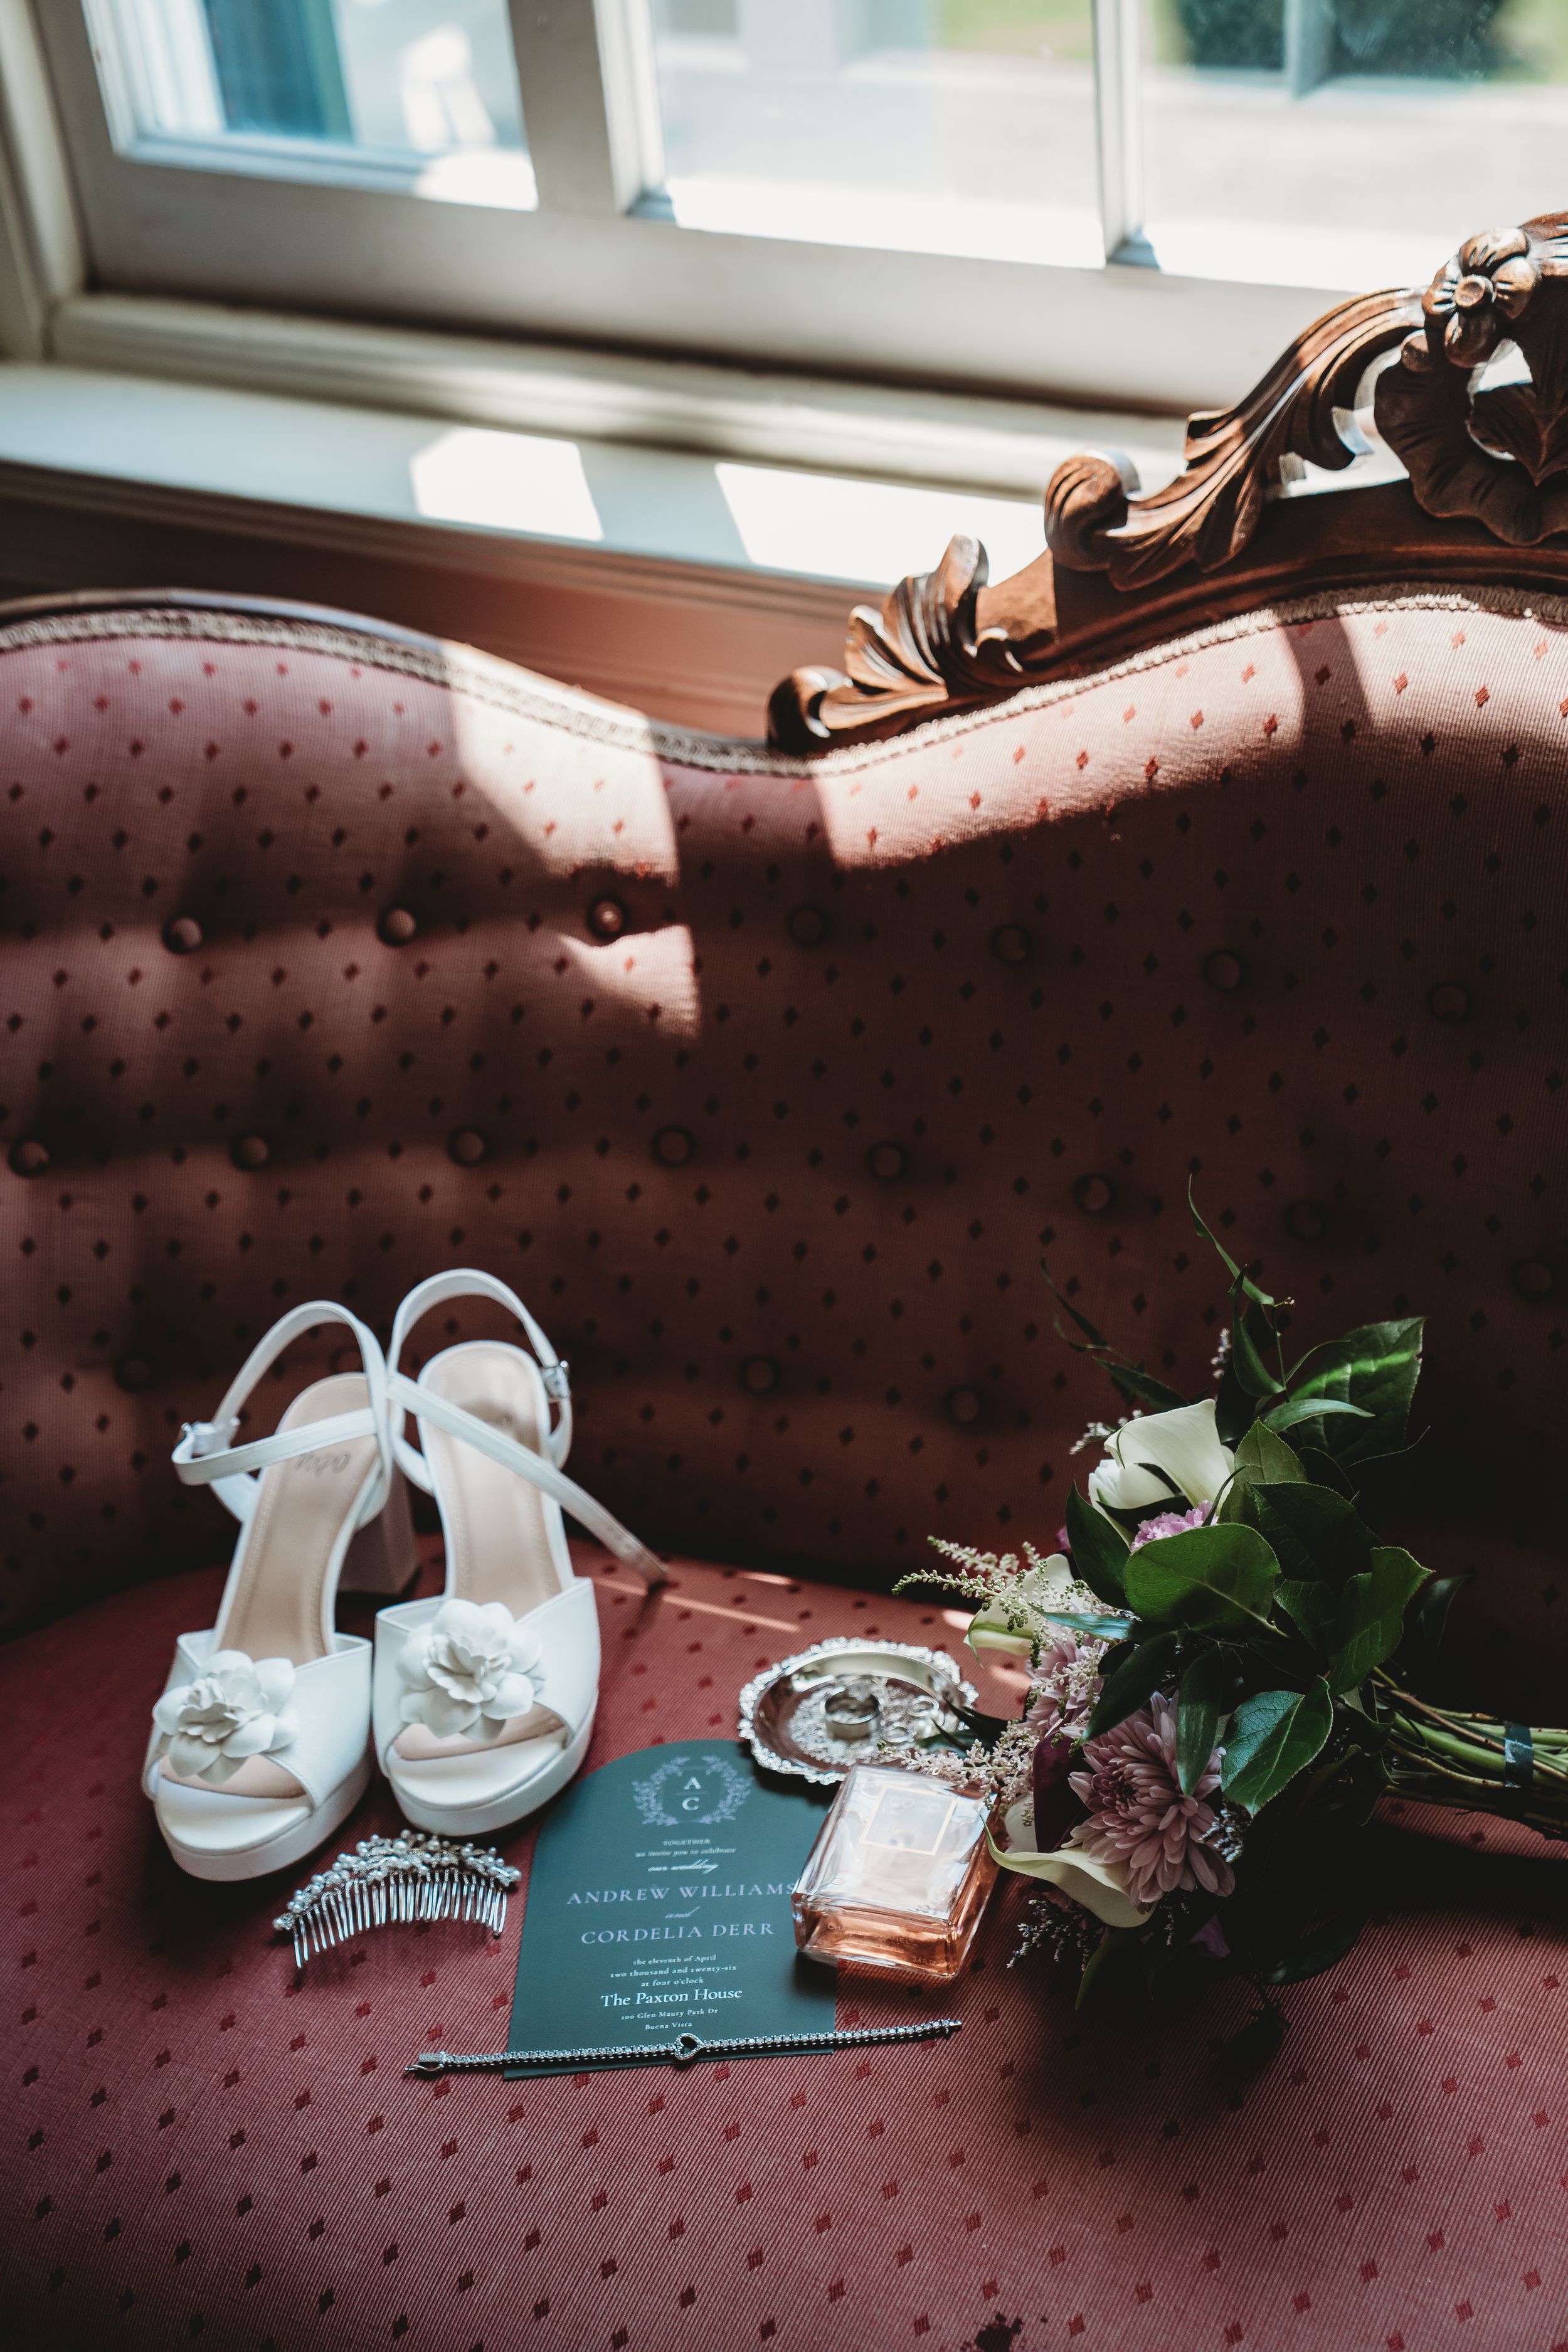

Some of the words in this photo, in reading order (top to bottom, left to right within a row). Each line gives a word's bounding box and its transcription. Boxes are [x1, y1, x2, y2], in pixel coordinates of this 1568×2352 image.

[684, 1776, 702, 1790] A
[682, 1796, 700, 1811] C
[889, 1797, 942, 1813] COCO
[670, 1859, 719, 1875] wedding
[566, 1887, 670, 1905] ANDREW
[679, 1883, 795, 1898] WILLIAMS
[664, 1905, 702, 1919] and
[581, 1926, 702, 1945] CORDELIA
[712, 1922, 775, 1937] DERR
[648, 1956, 682, 1964] eleventh
[694, 1954, 717, 1963] April
[629, 1968, 670, 1977] thousand
[672, 1966, 688, 1974] and
[691, 1965, 738, 1973] twenty-six
[674, 1977, 704, 1985] o'clock
[600, 1993, 631, 2007] The
[635, 1992, 689, 2005] Paxton
[693, 1988, 743, 2000] House
